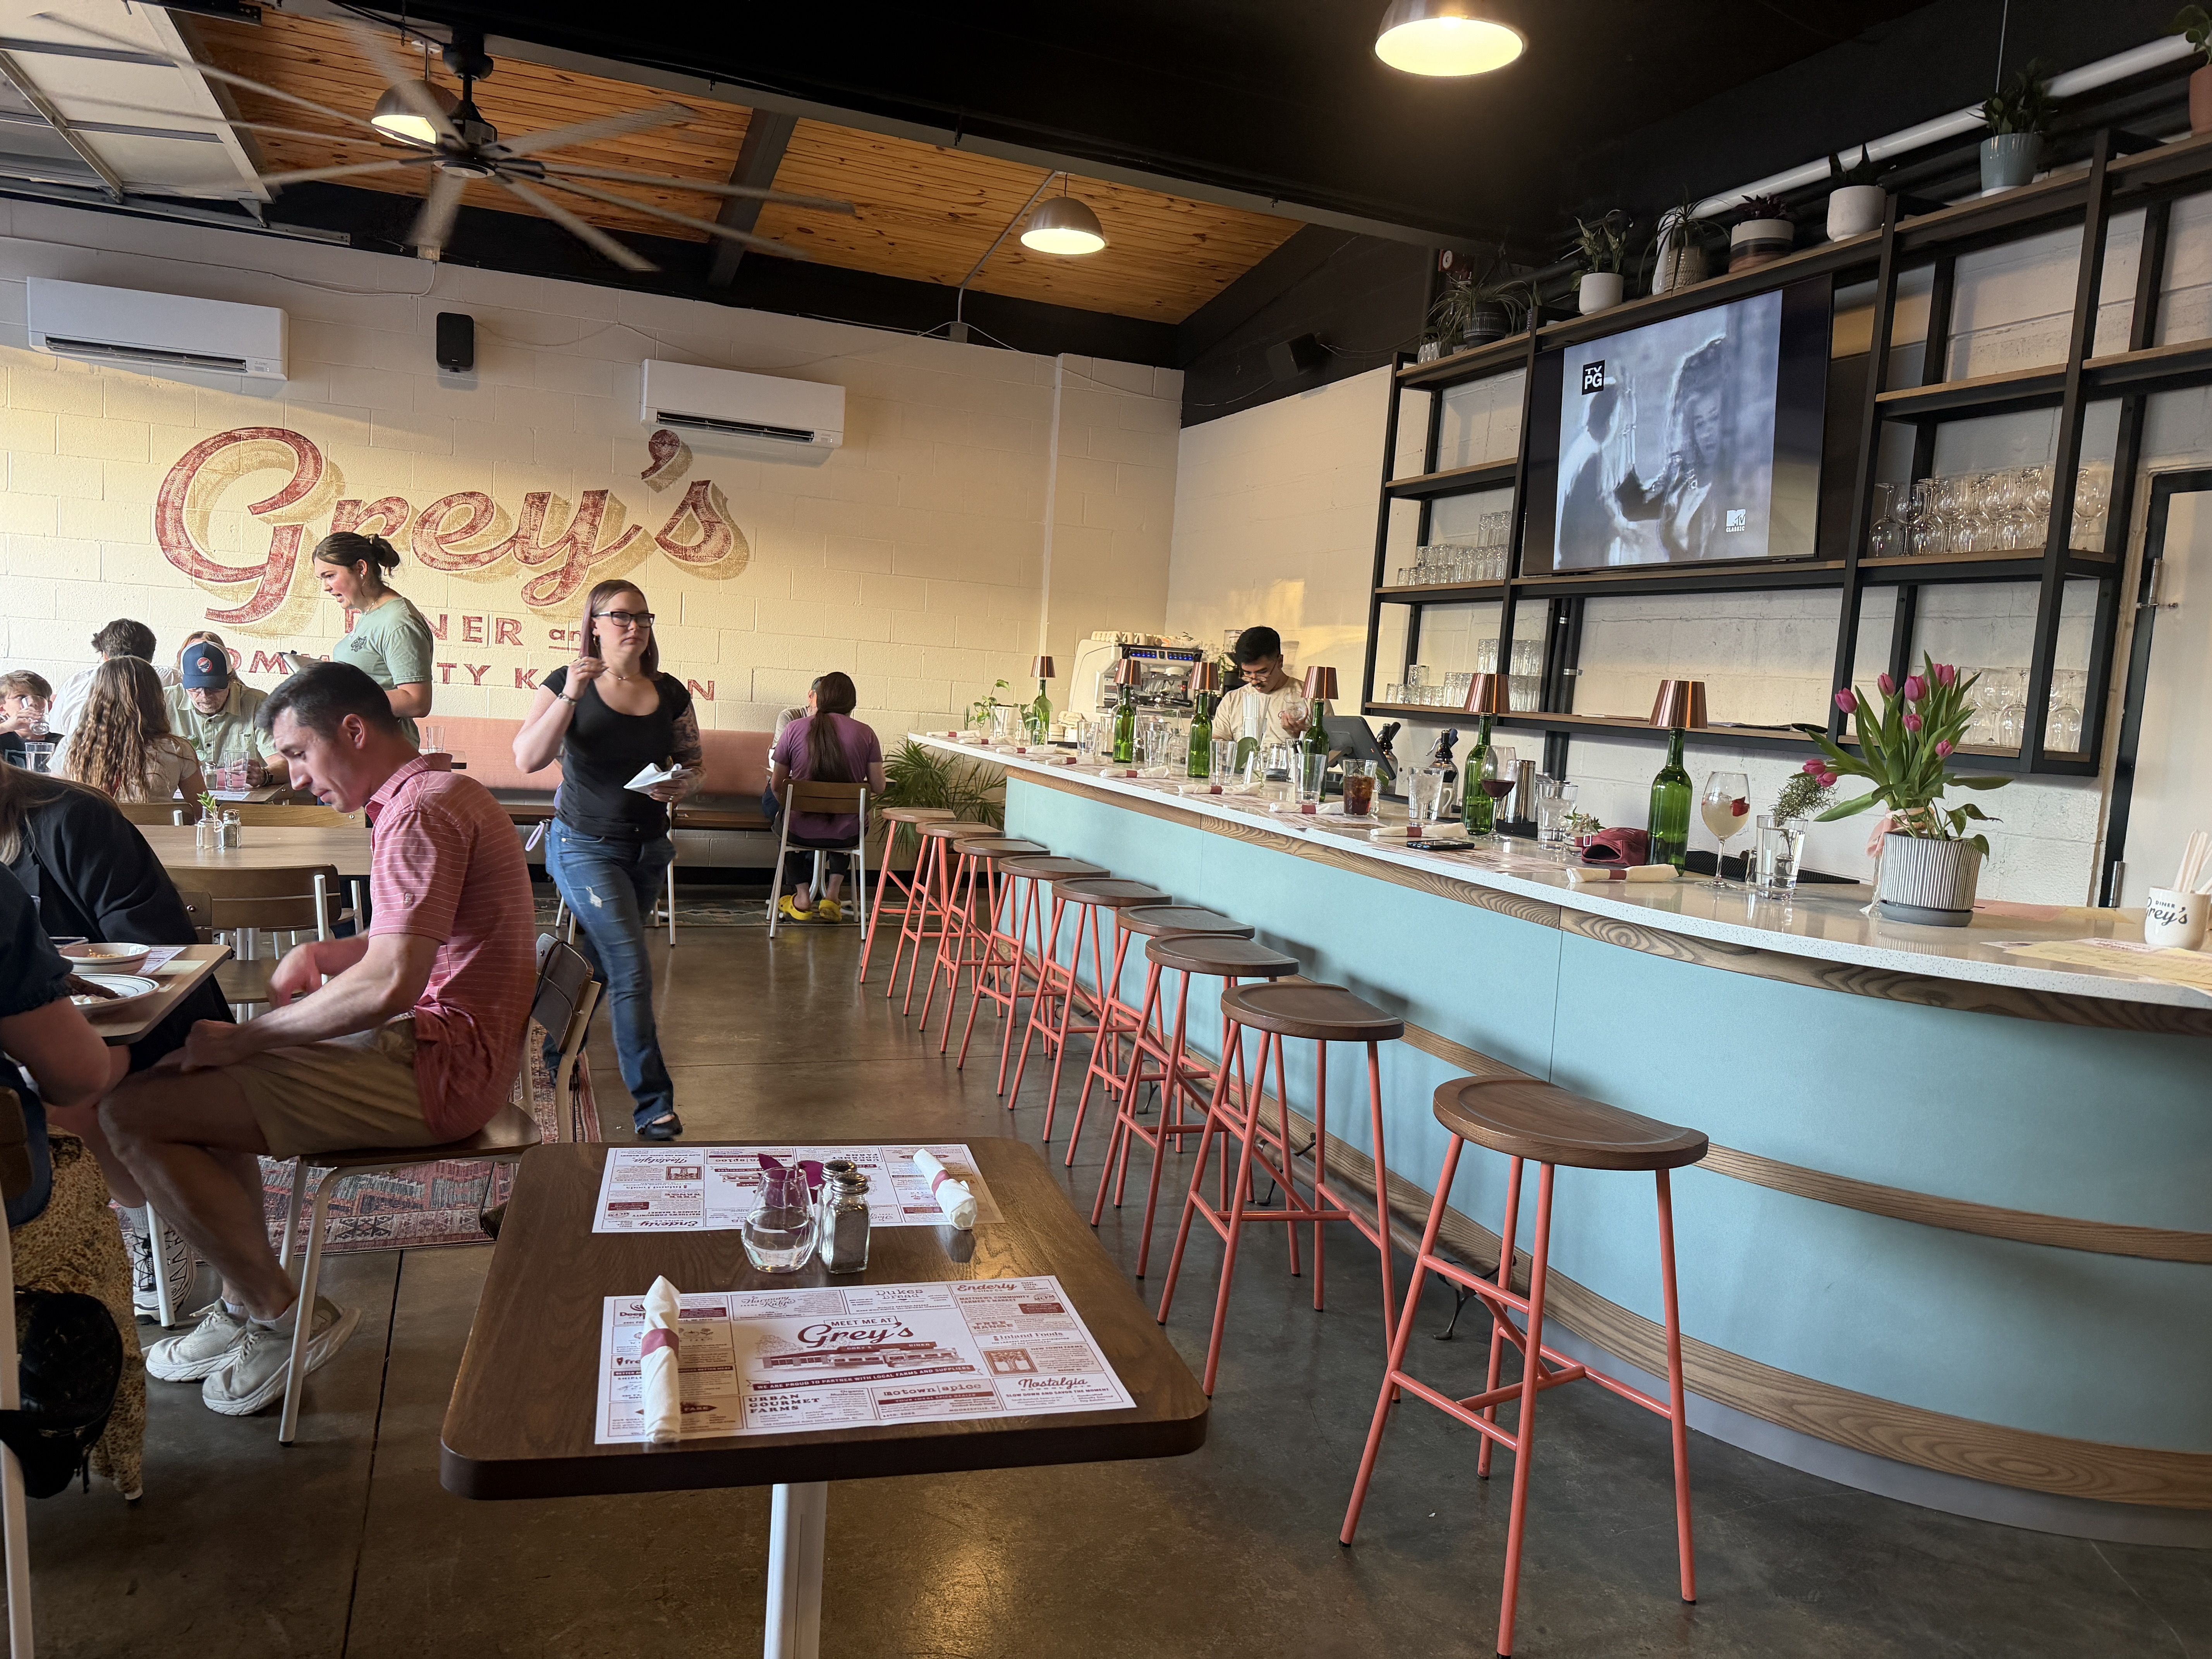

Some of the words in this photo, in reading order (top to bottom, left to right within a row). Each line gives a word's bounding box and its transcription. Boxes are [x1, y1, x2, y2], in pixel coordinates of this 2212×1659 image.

[1585, 365, 1602, 374] TV
[1584, 373, 1602, 390] PG
[1726, 509, 1746, 527] MTV
[155, 426, 736, 624] Grey's
[2155, 900, 2176, 908] DINER
[2147, 896, 2188, 926] rey's
[957, 1283, 1017, 1291] Enderly
[797, 1321, 914, 1348] Grey's
[941, 1383, 982, 1392] spice
[1018, 1377, 1088, 1389] Nostalgia
[749, 1398, 820, 1408] GOURMET
[750, 1405, 799, 1413] FARMS
